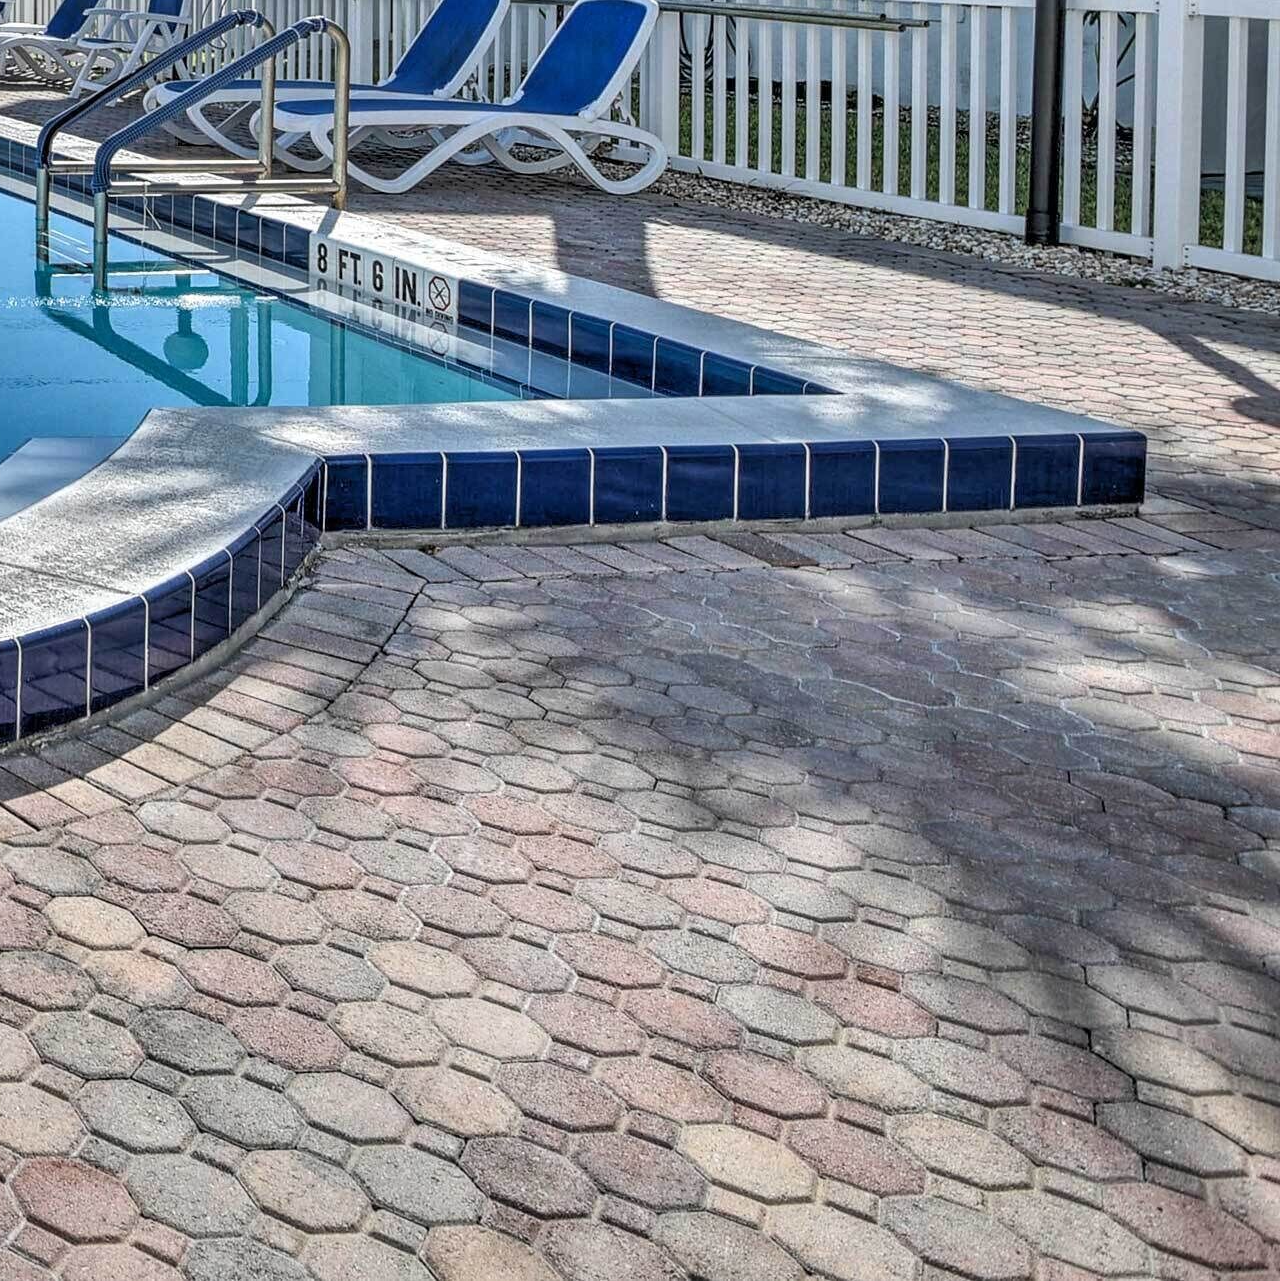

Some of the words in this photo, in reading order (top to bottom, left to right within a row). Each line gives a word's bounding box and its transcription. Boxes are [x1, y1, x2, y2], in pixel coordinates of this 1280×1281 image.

[317, 242, 328, 274] 8
[339, 248, 362, 286] FT.
[372, 260, 384, 293] 6
[395, 266, 422, 308] IN.
